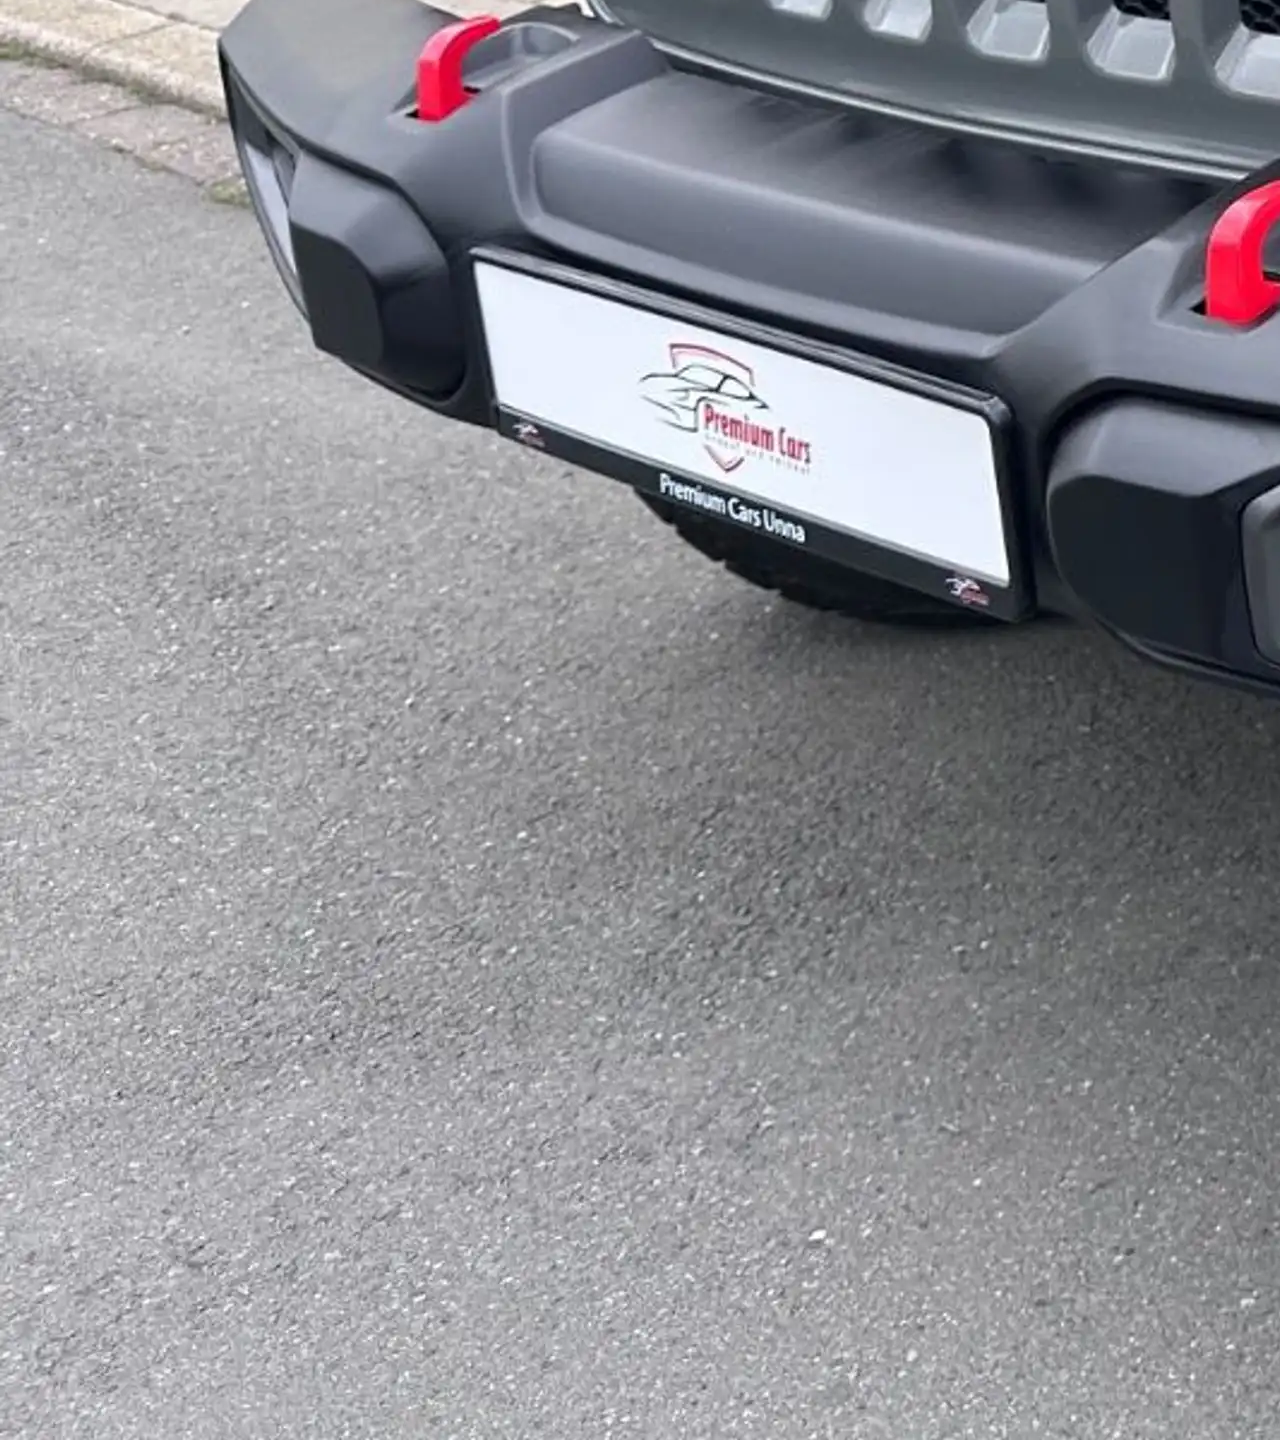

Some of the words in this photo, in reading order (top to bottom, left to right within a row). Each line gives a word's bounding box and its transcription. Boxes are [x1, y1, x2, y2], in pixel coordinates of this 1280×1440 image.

[703, 403, 774, 452] Premium
[778, 426, 811, 464] Cars
[659, 472, 726, 515] Premium
[727, 496, 762, 528] Cars
[763, 509, 806, 543] Unna
